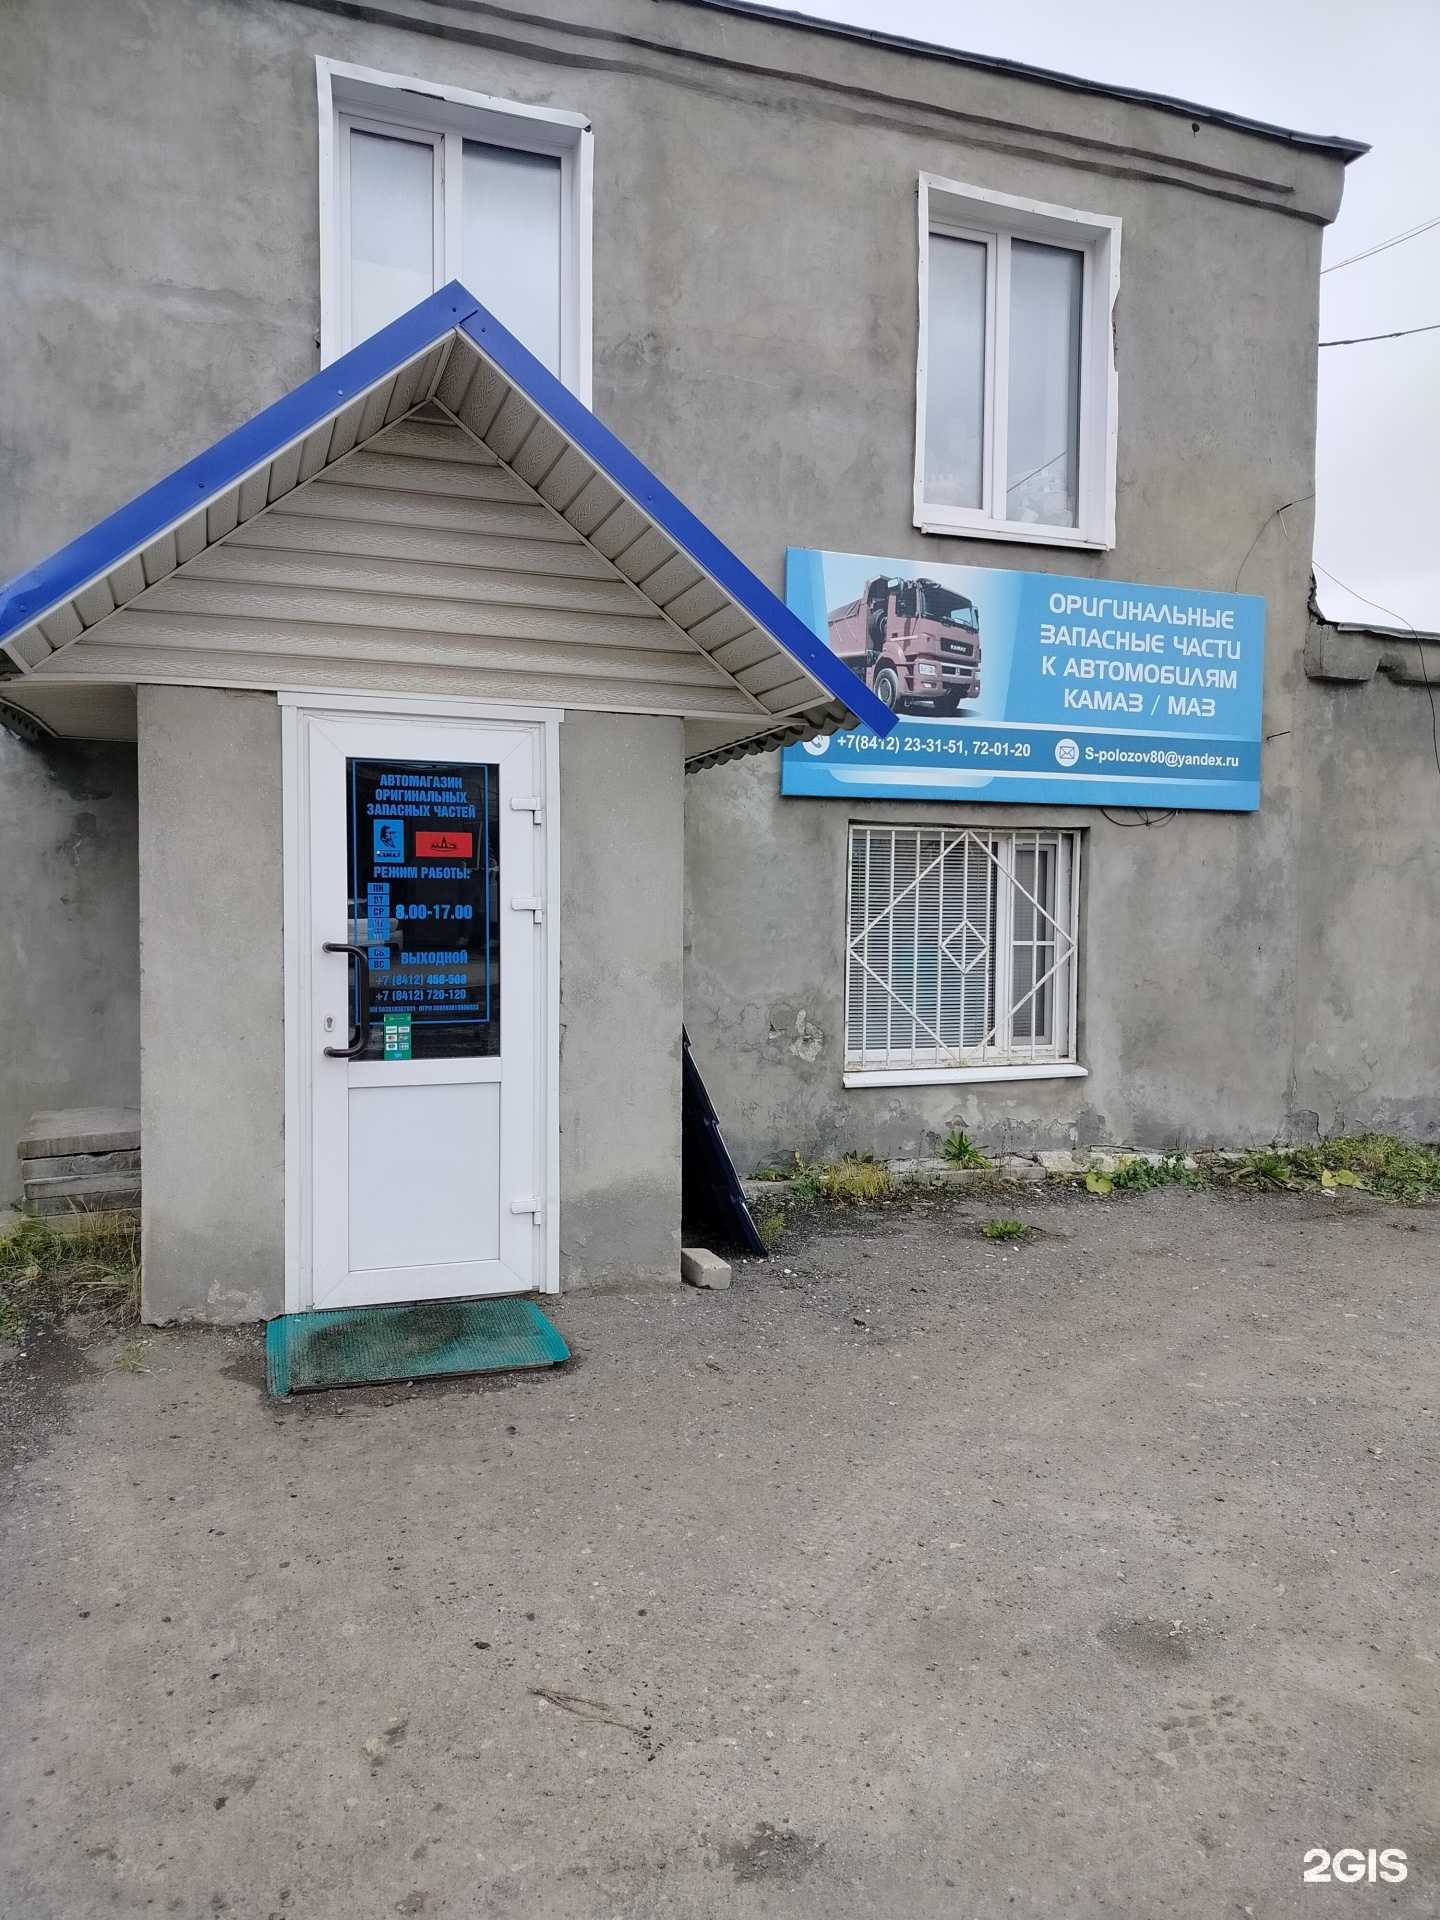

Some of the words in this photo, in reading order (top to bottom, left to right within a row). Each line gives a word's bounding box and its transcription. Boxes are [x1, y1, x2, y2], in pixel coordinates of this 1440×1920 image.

[1049, 592, 1234, 630] ОРИГИНАЛЬНЫЕ
[1040, 623, 1165, 654] ЗАПАСНЫЕ
[1173, 635, 1241, 660] ЧАСТИ
[1041, 655, 1057, 676] К
[1063, 657, 1238, 689] АВТОМОБИЛЯМ
[1064, 688, 1144, 713] КАМАЗ
[1150, 694, 1161, 716] /
[1167, 696, 1216, 718] МАЗ
[837, 734, 900, 755] +7(8412)
[903, 736, 968, 756] 23-31-51,
[972, 741, 1031, 758] 72-01-20
[1085, 747, 1239, 768] S-polozov80@yandex.ru
[380, 774, 463, 789] АВТОМАГАЗИН
[375, 789, 467, 803] ОРИГИНАЛЬНЫХ
[367, 803, 430, 817] ЗАПАСНЫХ
[433, 804, 476, 818] ЧАСТЕЙ
[374, 866, 417, 879] РЕЖИМ
[420, 867, 471, 880] РАБОТЫ:
[395, 904, 473, 920] 8.00-17.00
[400, 950, 468, 966] ВЫХОДНОЙ
[375, 990, 389, 1001] +7
[392, 990, 424, 1001] (8412)
